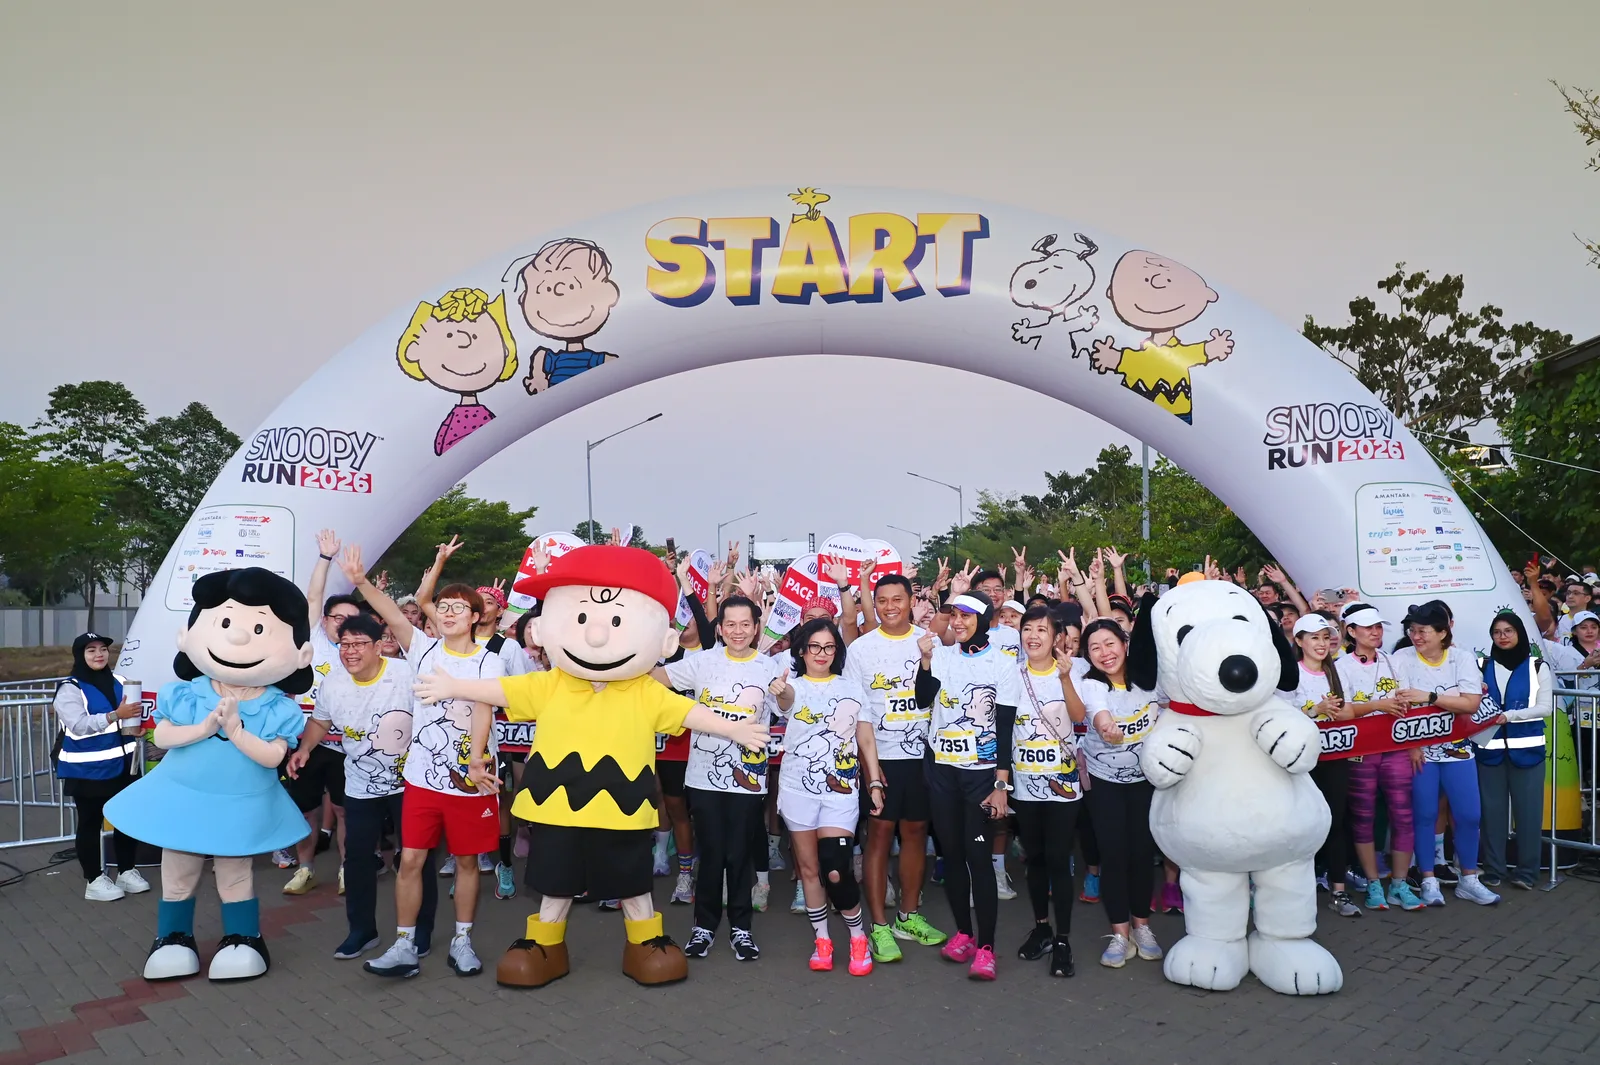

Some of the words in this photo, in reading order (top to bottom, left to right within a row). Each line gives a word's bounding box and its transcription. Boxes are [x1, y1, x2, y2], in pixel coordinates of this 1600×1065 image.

[645, 213, 990, 308] START
[1263, 402, 1394, 446] SNOOPY
[245, 427, 377, 471] SNOOPY
[1268, 442, 1333, 470] RUN
[1341, 440, 1404, 461] 2026
[241, 463, 296, 486] RUN
[302, 467, 370, 493] 2026
[1374, 492, 1411, 500] AMANTARA
[1407, 528, 1427, 536] TipTip
[828, 543, 863, 553] AMANTARA
[702, 588, 707, 599] 8
[785, 577, 815, 601] PACE
[1118, 714, 1150, 735] 7695
[1393, 712, 1455, 741] START
[940, 738, 970, 752] 7351
[1019, 748, 1056, 763] 7606
